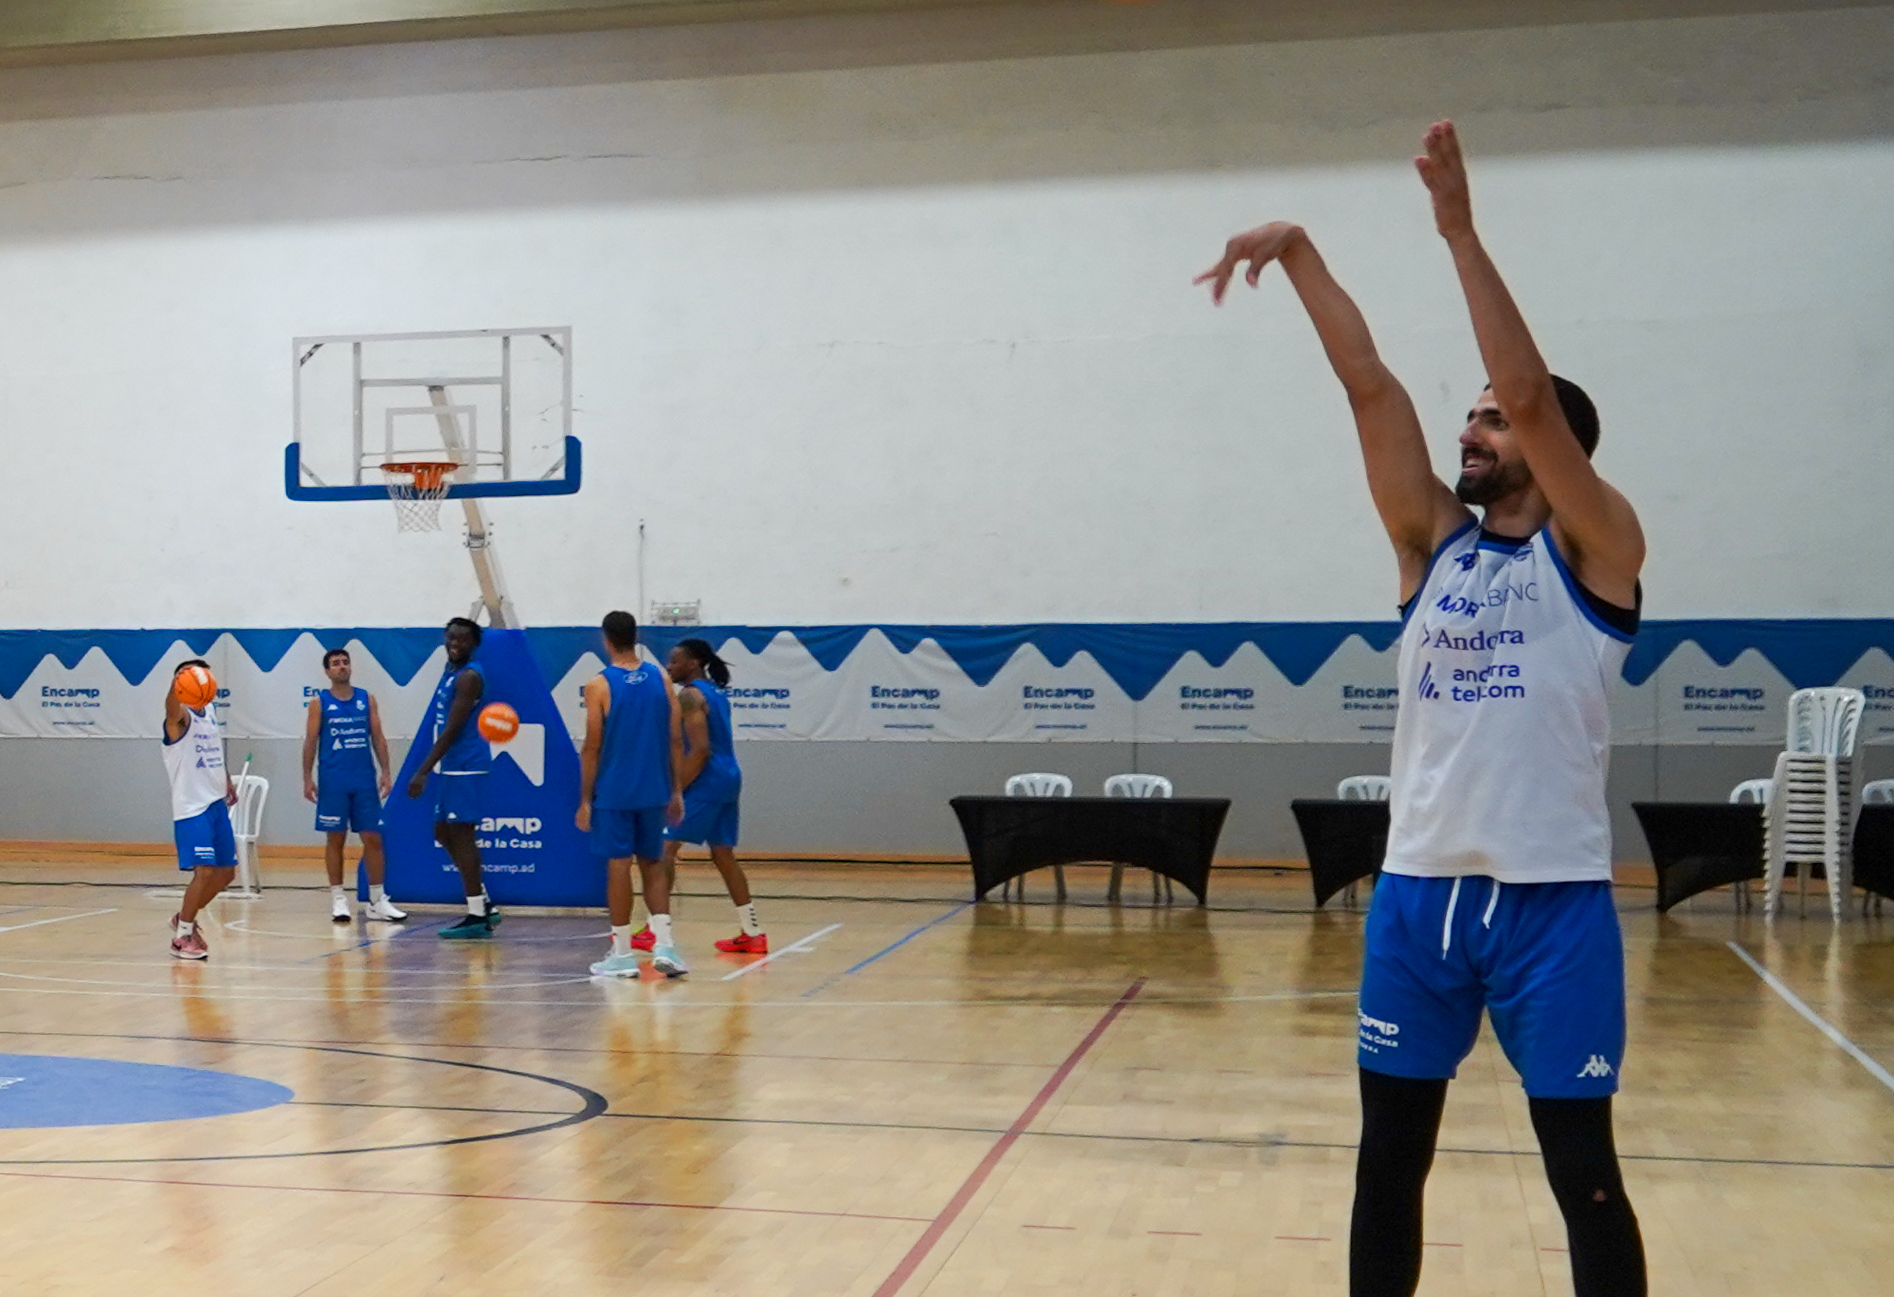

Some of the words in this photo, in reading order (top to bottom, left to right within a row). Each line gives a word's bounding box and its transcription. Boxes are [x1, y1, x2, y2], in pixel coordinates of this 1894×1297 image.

[42, 686, 100, 698] Encamp
[727, 686, 790, 699] Encamp
[871, 686, 940, 700] Encamp
[1023, 686, 1095, 699] Encamp
[1180, 686, 1254, 700] Encamp
[1684, 685, 1764, 700] Encamp
[495, 838, 507, 849] la
[510, 838, 542, 849] Casa
